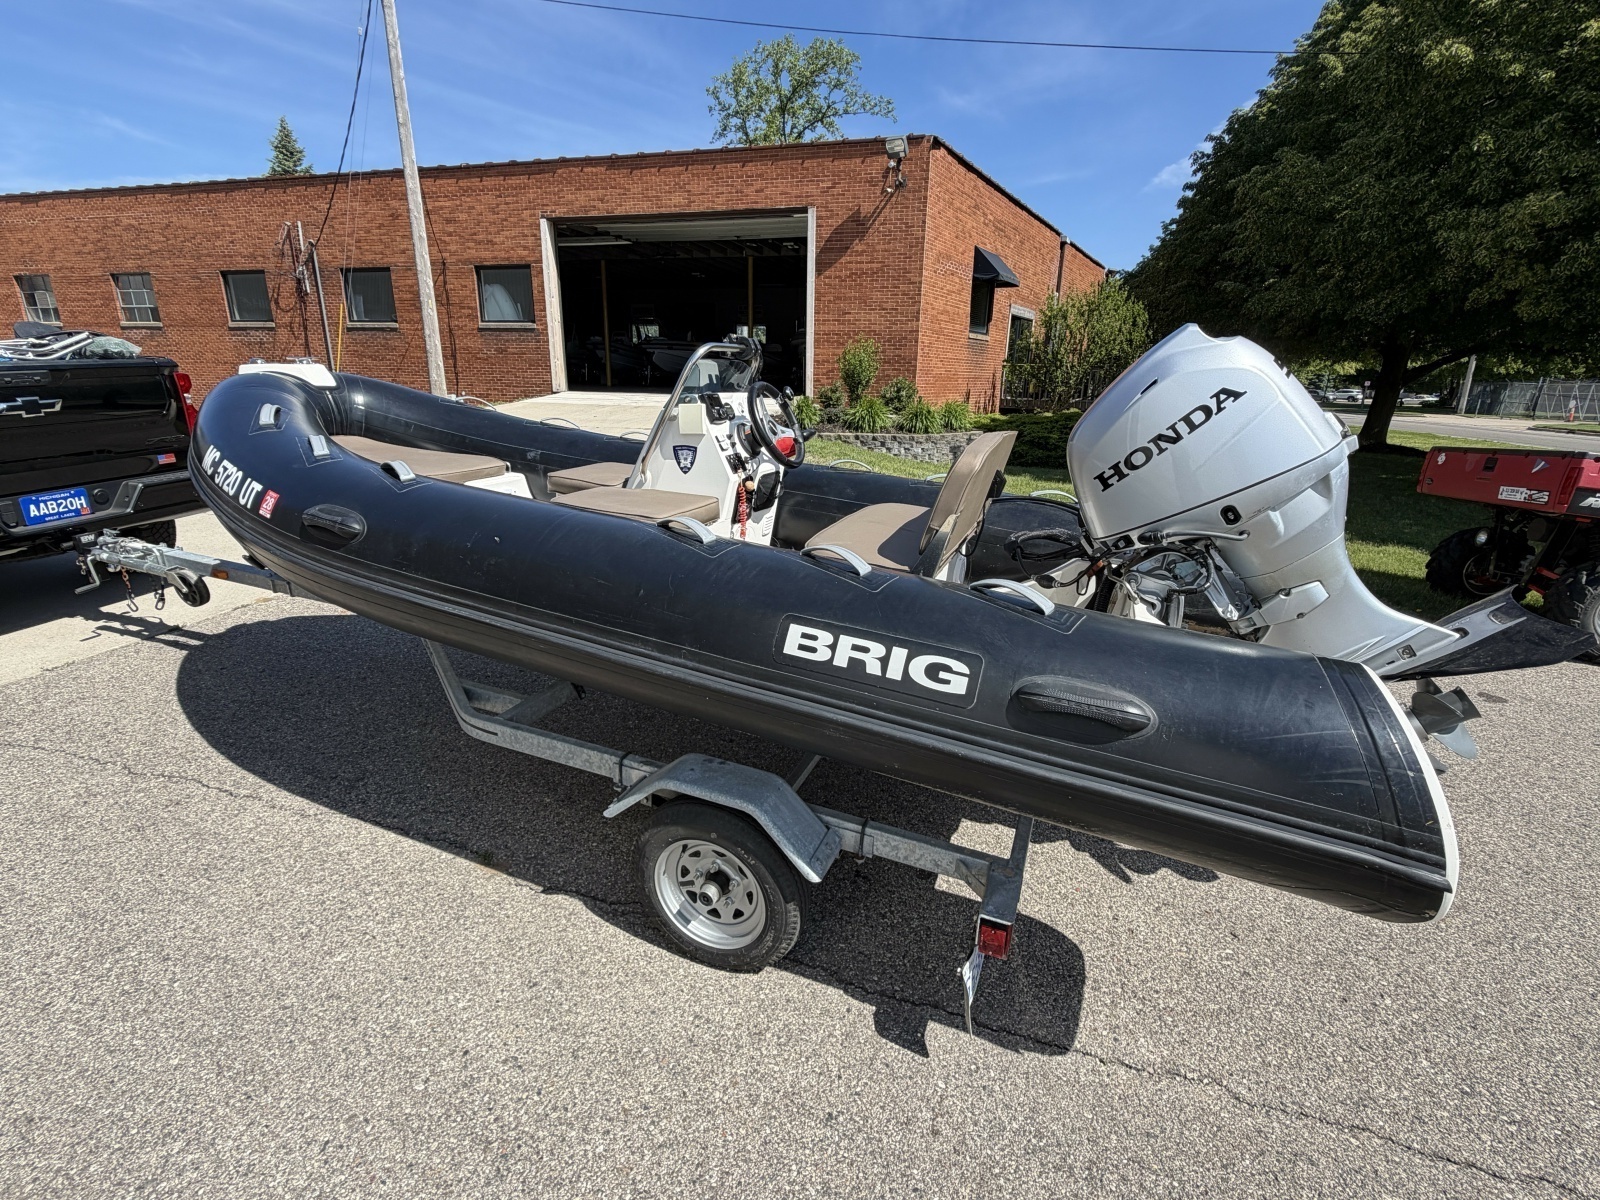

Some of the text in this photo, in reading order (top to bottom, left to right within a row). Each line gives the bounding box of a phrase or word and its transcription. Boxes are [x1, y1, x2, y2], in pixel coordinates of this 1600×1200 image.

[1093, 387, 1247, 492] HONDA
[39, 492, 69, 500] MICHIGAN
[202, 445, 264, 509] MC 5720 UT
[29, 496, 86, 517] AAB20H
[262, 495, 275, 511] 28
[782, 623, 970, 695] BRIG
